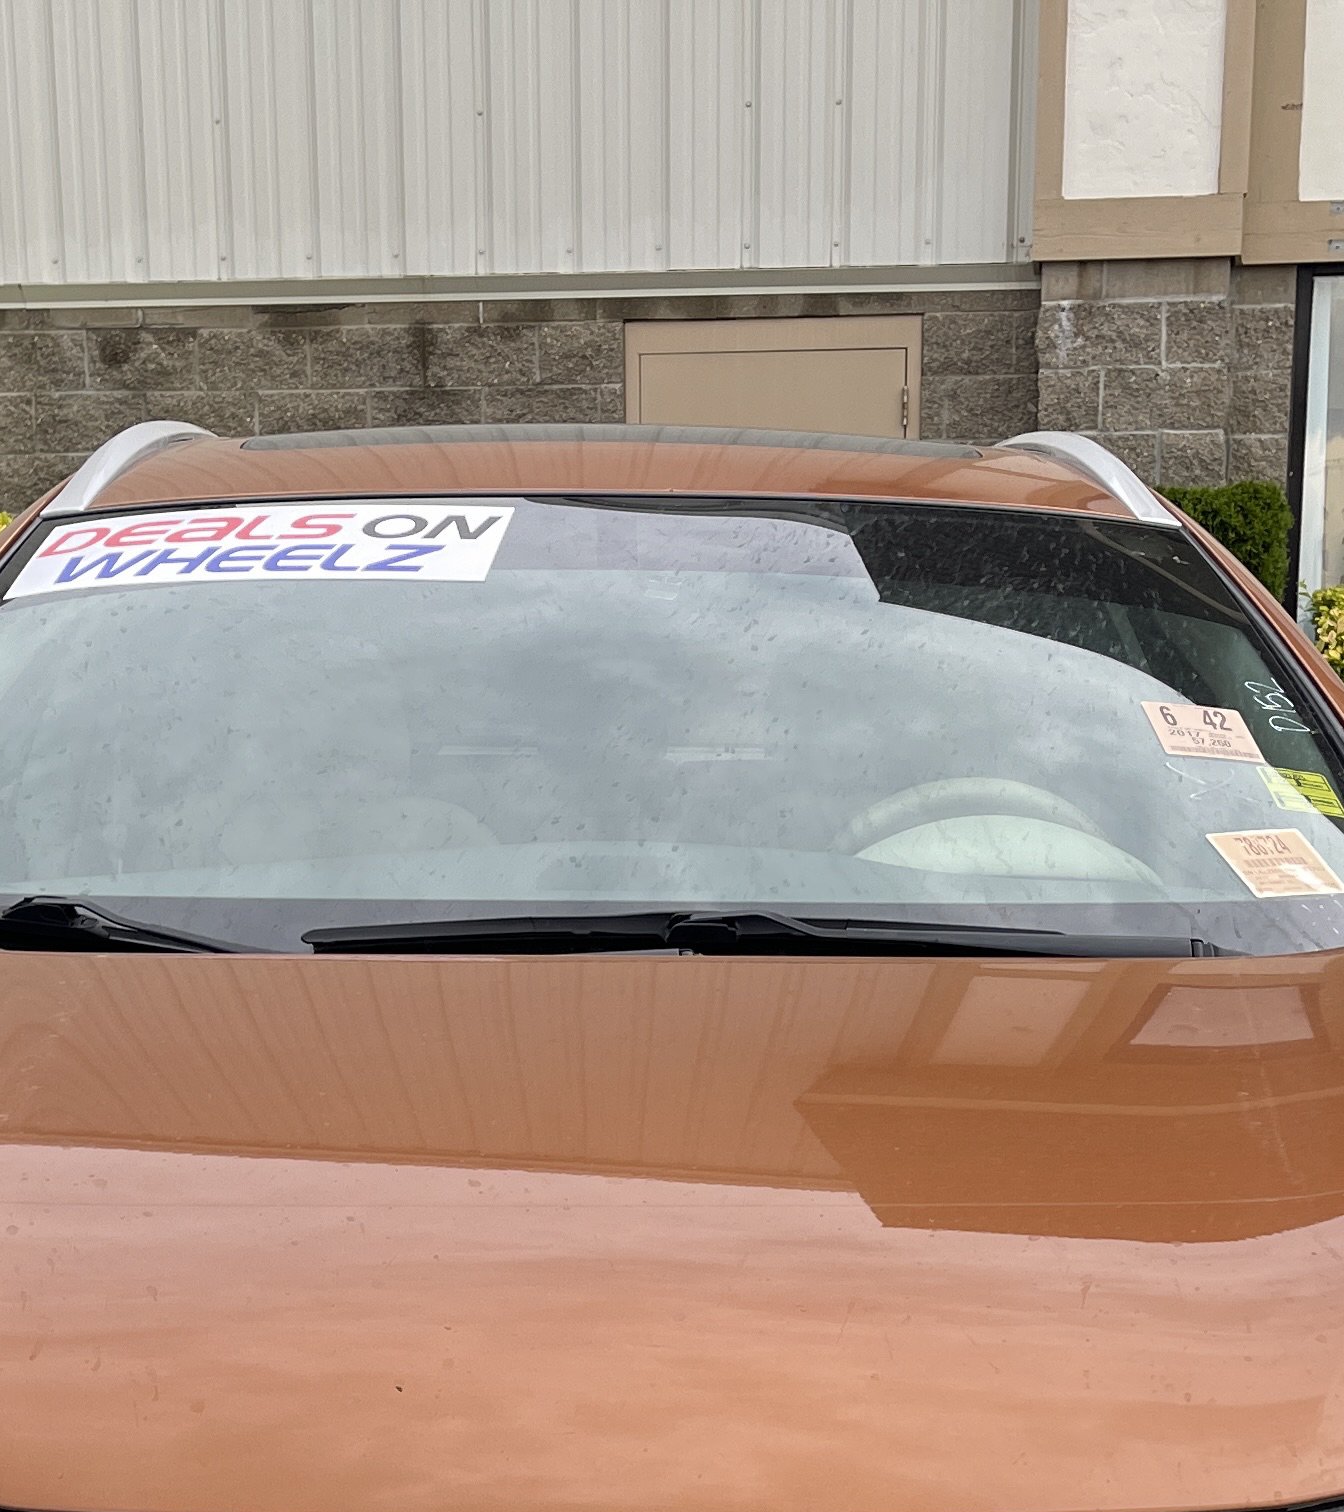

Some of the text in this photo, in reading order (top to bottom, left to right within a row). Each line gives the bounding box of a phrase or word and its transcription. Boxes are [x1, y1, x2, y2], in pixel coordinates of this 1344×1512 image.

[362, 513, 502, 541] ON
[53, 543, 448, 584] WHEELZ
[1159, 705, 1178, 726] 6
[1202, 709, 1233, 732] 42
[1168, 728, 1201, 737] 2017
